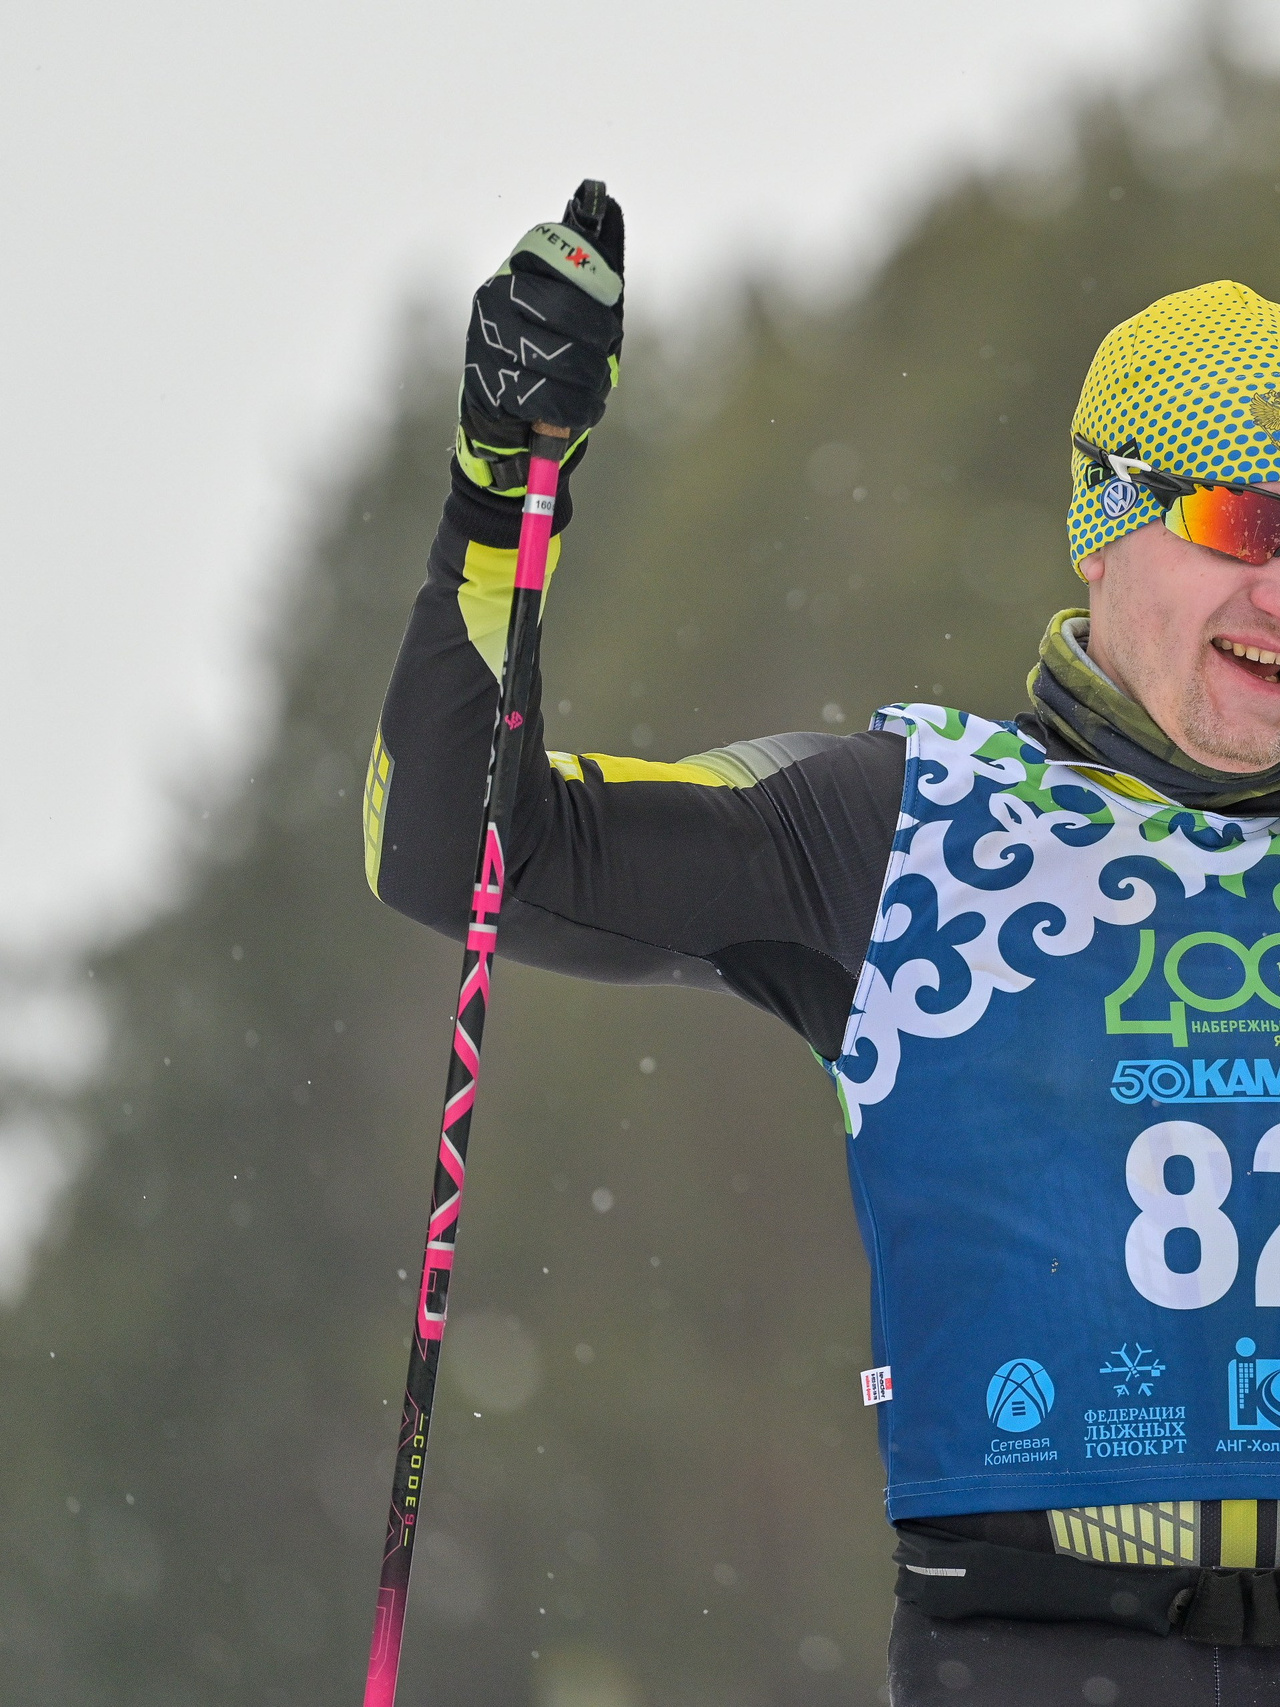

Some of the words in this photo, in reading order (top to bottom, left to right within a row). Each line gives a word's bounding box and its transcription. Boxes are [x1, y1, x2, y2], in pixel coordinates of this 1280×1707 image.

[535, 500, 552, 510] 160
[1084, 1406, 1186, 1424] ФЕДЕРАЦИЯ
[1084, 1421, 1186, 1441] ЛЫЖНЫХ
[990, 1437, 1050, 1453] Сетевая
[1085, 1441, 1158, 1459] ГОНОК
[1161, 1438, 1187, 1455] РТ
[984, 1450, 1058, 1466] Компания
